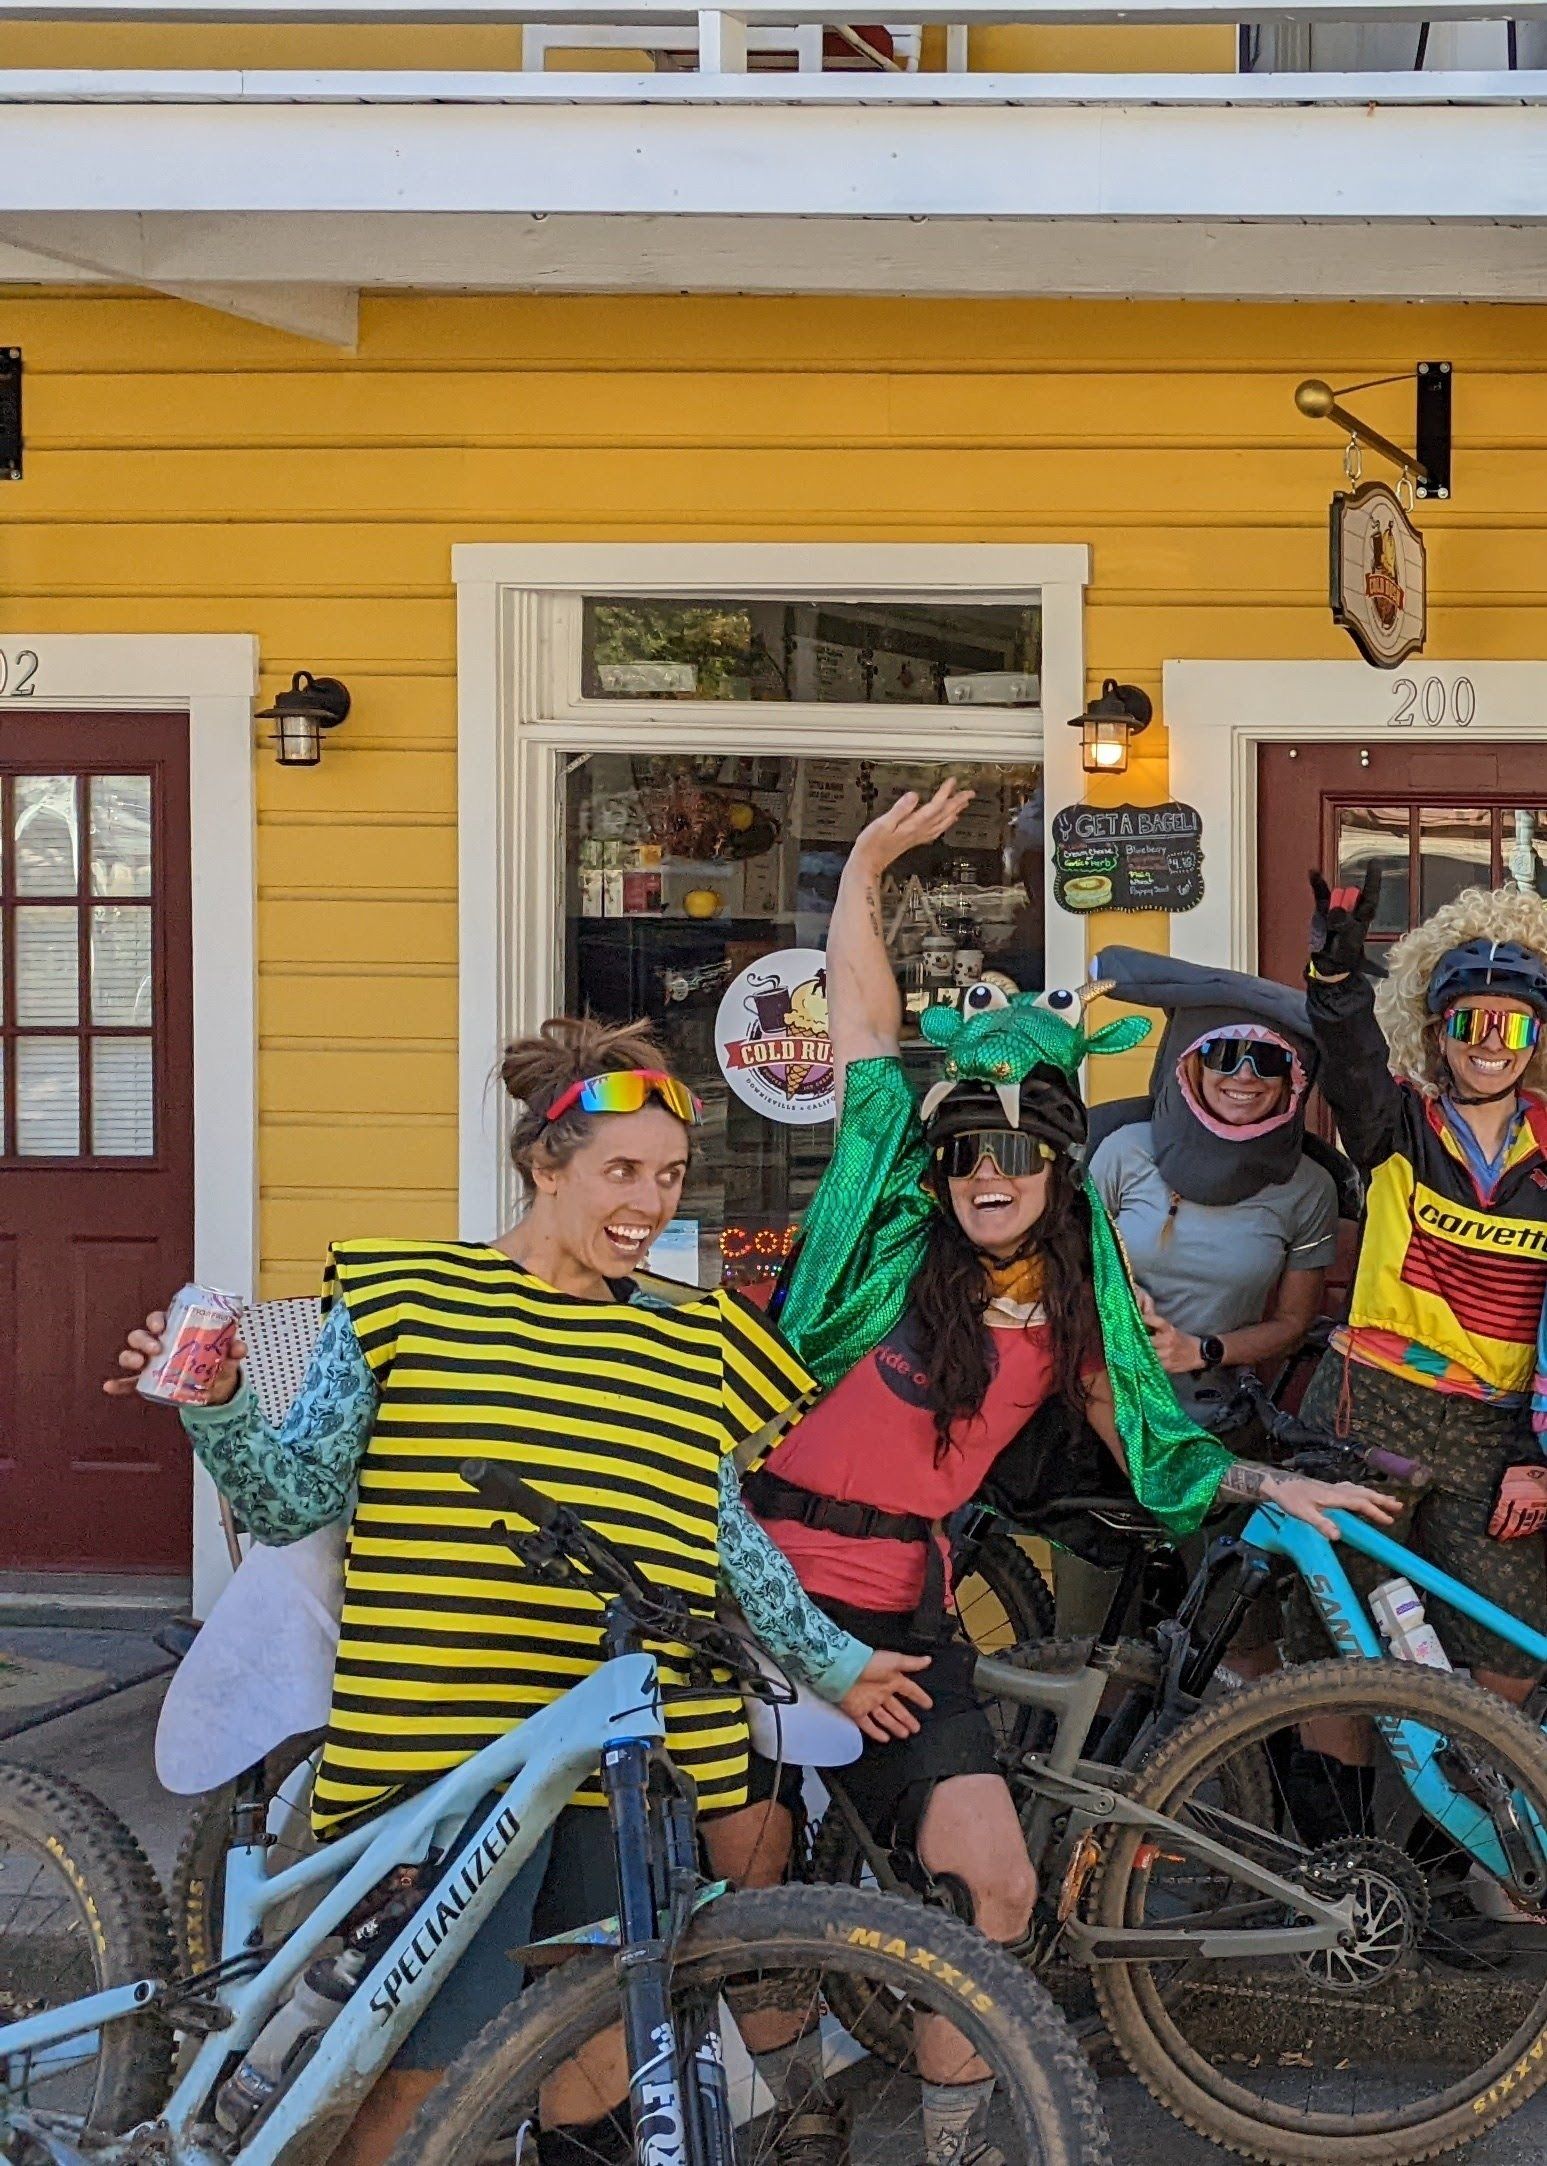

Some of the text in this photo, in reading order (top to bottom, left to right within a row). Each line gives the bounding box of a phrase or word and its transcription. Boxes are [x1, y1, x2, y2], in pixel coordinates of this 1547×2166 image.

[1388, 676, 1475, 727] 200
[1075, 813, 1118, 838] GET
[1120, 813, 1134, 835] A
[1125, 844, 1166, 856] Blueberry
[741, 1041, 795, 1064] COLD
[369, 1807, 520, 2027] SPECIALIZED
[847, 1927, 994, 2013] MAXXIS
